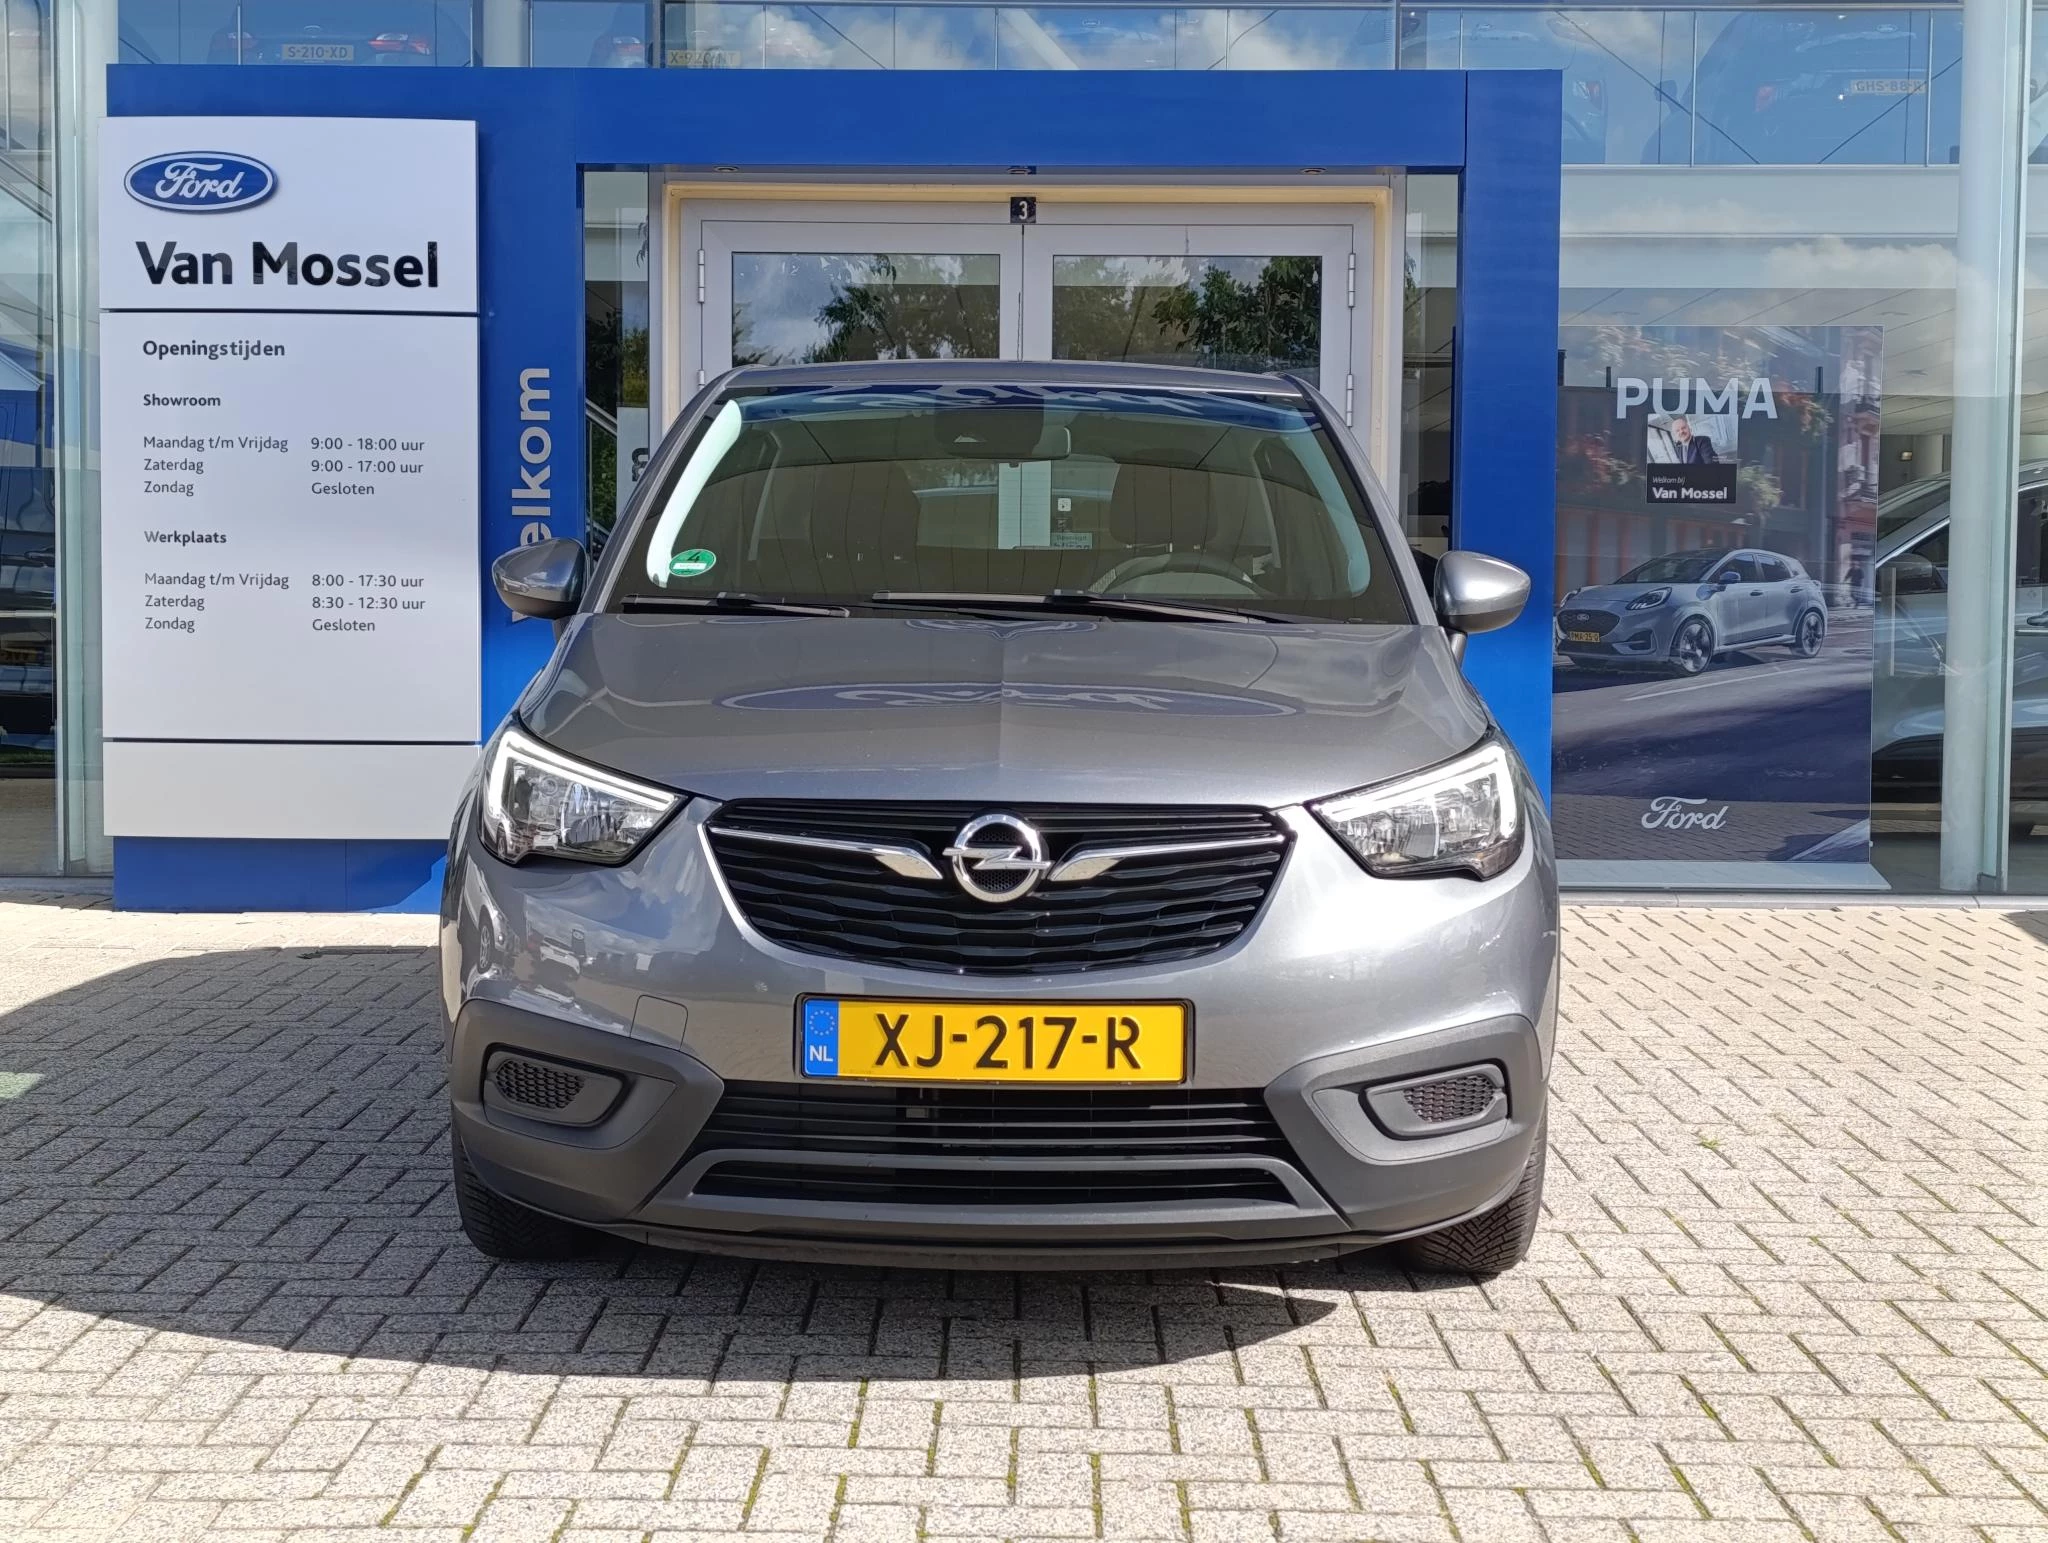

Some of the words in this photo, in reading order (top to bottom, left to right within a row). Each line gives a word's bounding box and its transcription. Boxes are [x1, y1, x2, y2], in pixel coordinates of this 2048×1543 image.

[288, 46, 348, 59] S-210-XD
[155, 162, 245, 199] Ford
[1019, 201, 1028, 220] 3
[135, 241, 233, 285] Van
[252, 241, 439, 288] Mossel
[142, 339, 285, 361] Openingstijden
[143, 393, 221, 407] Showroom
[1616, 377, 1778, 420] PUMA
[143, 435, 205, 453] Maandag
[208, 435, 235, 449] t/m
[238, 436, 289, 453] Vrijdag
[310, 437, 344, 450] 9:00
[357, 438, 397, 451] 18:00
[401, 441, 425, 451] uur
[143, 458, 204, 475] Zaterdag
[310, 460, 344, 472] 9:00
[357, 460, 396, 473] 17:00
[400, 463, 424, 473] uur
[143, 480, 194, 497] Zondag
[311, 481, 375, 495] Gesloten
[512, 368, 552, 622] elkom
[1652, 487, 1678, 499] Van
[1681, 486, 1728, 500] Mossel
[144, 530, 228, 547] Werkplaats
[144, 571, 206, 590] Maandag
[209, 572, 235, 587] t/m
[238, 573, 290, 590] Vrijdag
[311, 573, 345, 587] 8:00
[358, 574, 397, 588] 17:30
[400, 577, 425, 588] uur
[144, 594, 206, 612] Zaterdag
[311, 596, 345, 609] 8:30
[358, 596, 398, 610] 12:30
[401, 600, 426, 610] uur
[144, 617, 196, 634] Zondag
[311, 618, 376, 632] Gesloten
[1641, 796, 1729, 829] Ford
[874, 1012, 1141, 1070] XJ-217-R
[809, 1045, 834, 1062] NL
